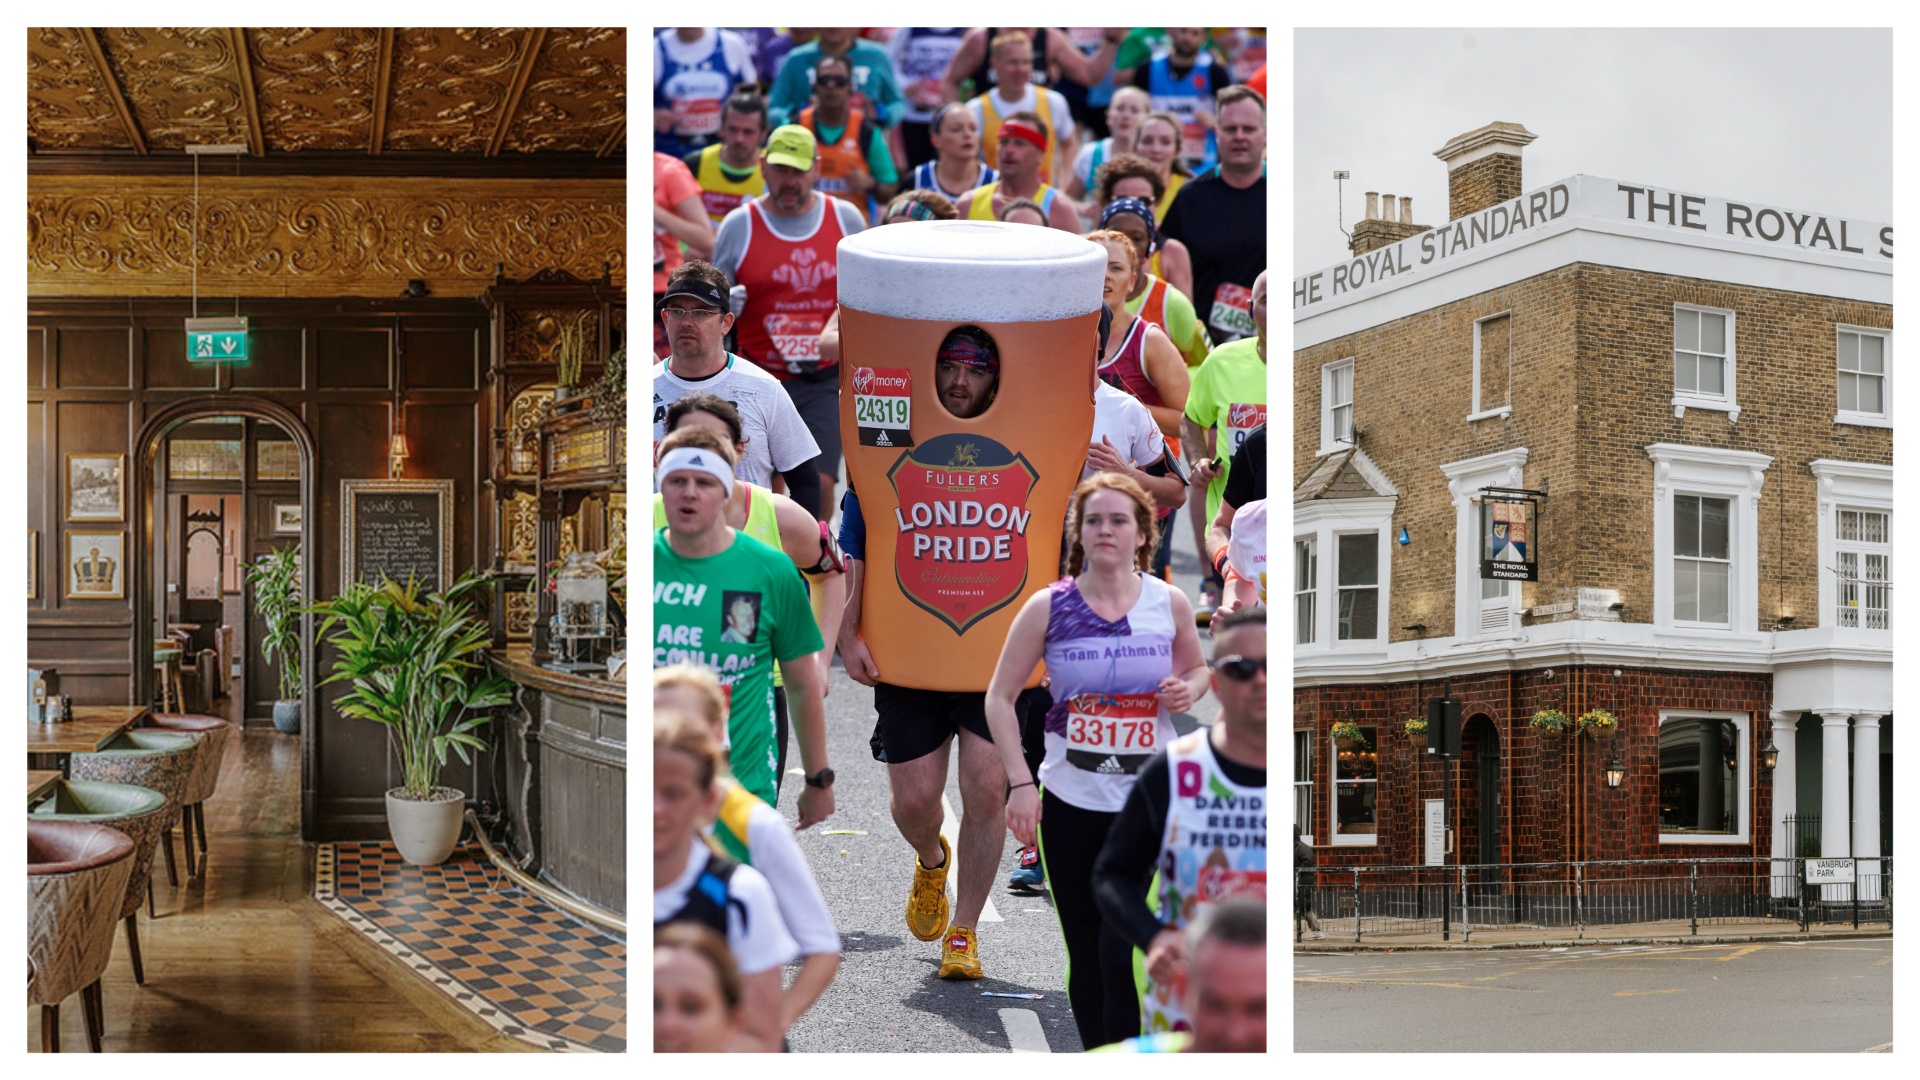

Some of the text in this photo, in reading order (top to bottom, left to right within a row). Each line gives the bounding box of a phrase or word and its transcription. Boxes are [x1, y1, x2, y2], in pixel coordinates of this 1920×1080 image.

[1617, 183, 1707, 232] THE
[1725, 202, 1864, 255] ROYAL
[1333, 243, 1412, 296] ROYAL
[1420, 184, 1569, 264] STANDARD
[854, 367, 907, 393] Virgin money
[857, 397, 908, 424] 24319
[926, 470, 999, 486] FULLER'S
[894, 500, 1031, 536] LONDON
[913, 533, 1013, 563] PRIDE
[921, 567, 1001, 586] Outstanding
[1492, 562, 1529, 571] THE ROYAL
[1492, 571, 1529, 579] STANDARD
[656, 623, 704, 648] ARE
[1061, 648, 1099, 661] Team
[1104, 645, 1157, 659] Asthma
[1070, 717, 1155, 748] 33178
[1195, 796, 1262, 810] DAVID
[1816, 860, 1854, 868] VANBRUGH
[1816, 869, 1835, 877] PARK
